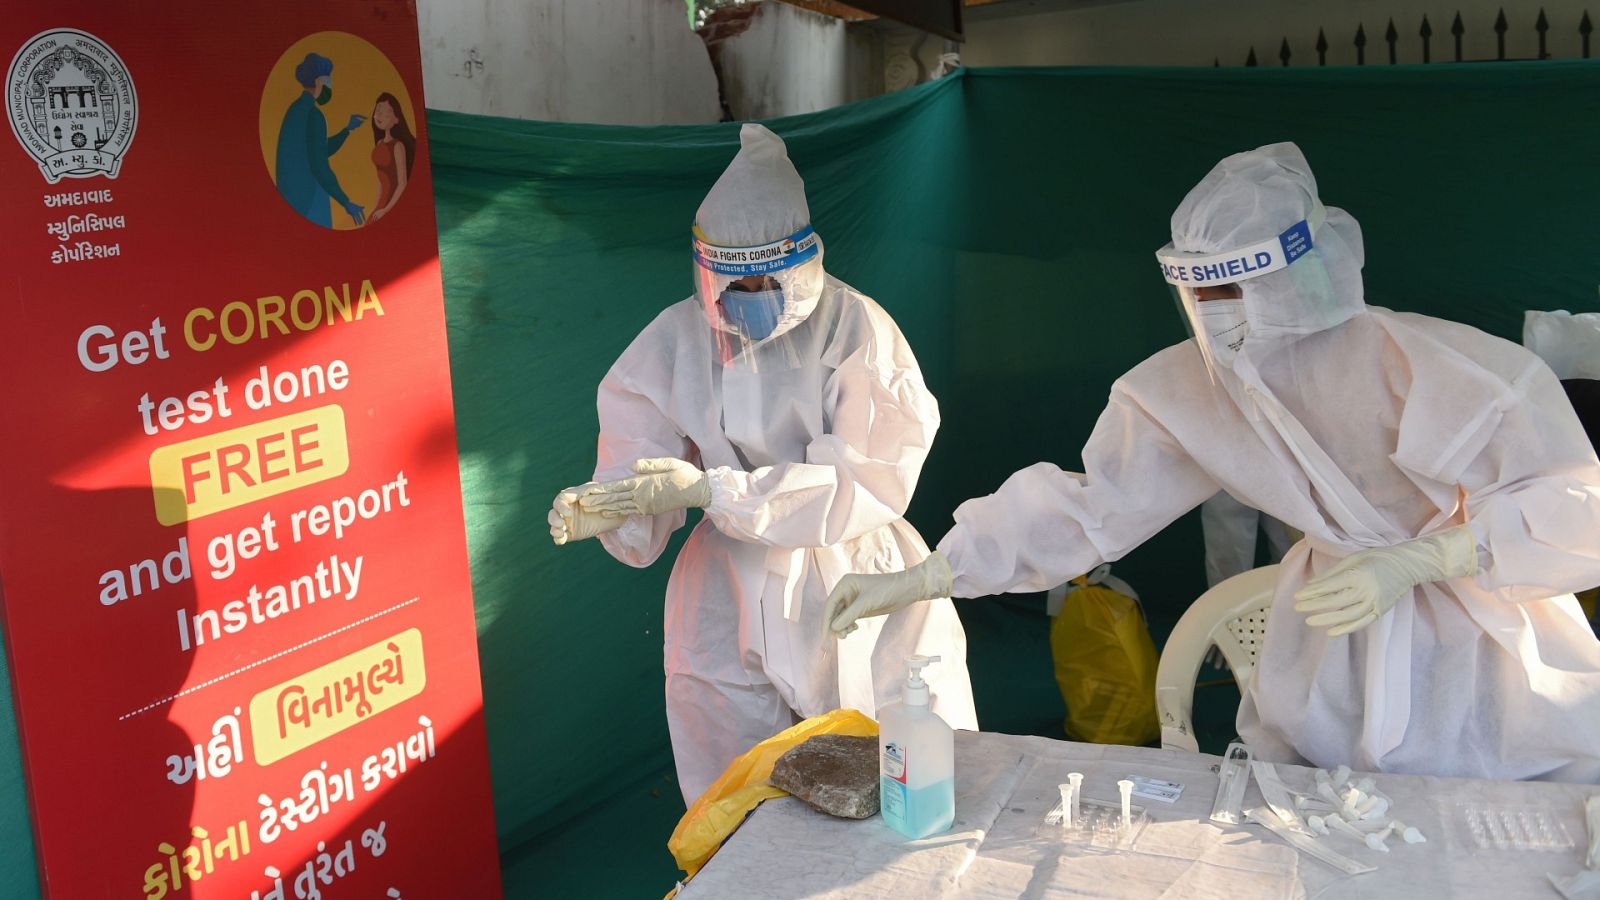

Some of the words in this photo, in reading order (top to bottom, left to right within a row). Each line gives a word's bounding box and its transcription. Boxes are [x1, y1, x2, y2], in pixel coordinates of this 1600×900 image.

[18, 40, 56, 77] CORPORATION
[15, 80, 24, 121] MUNICIPAL
[21, 122, 46, 154] AMDAVAD
[44, 190, 113, 207] અમદાવાદ
[47, 213, 125, 240] મ્યુનિસિપલ
[720, 251, 746, 262] FIGHTS
[749, 246, 782, 260] CORONA
[751, 264, 767, 272] Stay
[769, 260, 787, 270] Safe.
[1193, 252, 1272, 282] SHIELD
[77, 316, 170, 372] Get
[183, 279, 385, 352] CORONA
[138, 376, 232, 436] test
[244, 358, 350, 410] done
[181, 423, 324, 505] FREE
[98, 537, 192, 606] and
[207, 512, 280, 580] get
[291, 470, 410, 539] report
[176, 555, 364, 651] Instantly
[165, 706, 244, 785] અહીં
[276, 641, 404, 739] વિનામૂલ્યે
[143, 820, 251, 900] કોરોના
[258, 761, 355, 844] ટેસ્ટીંગ
[360, 715, 436, 791] કરાવો
[361, 821, 387, 857] જ
